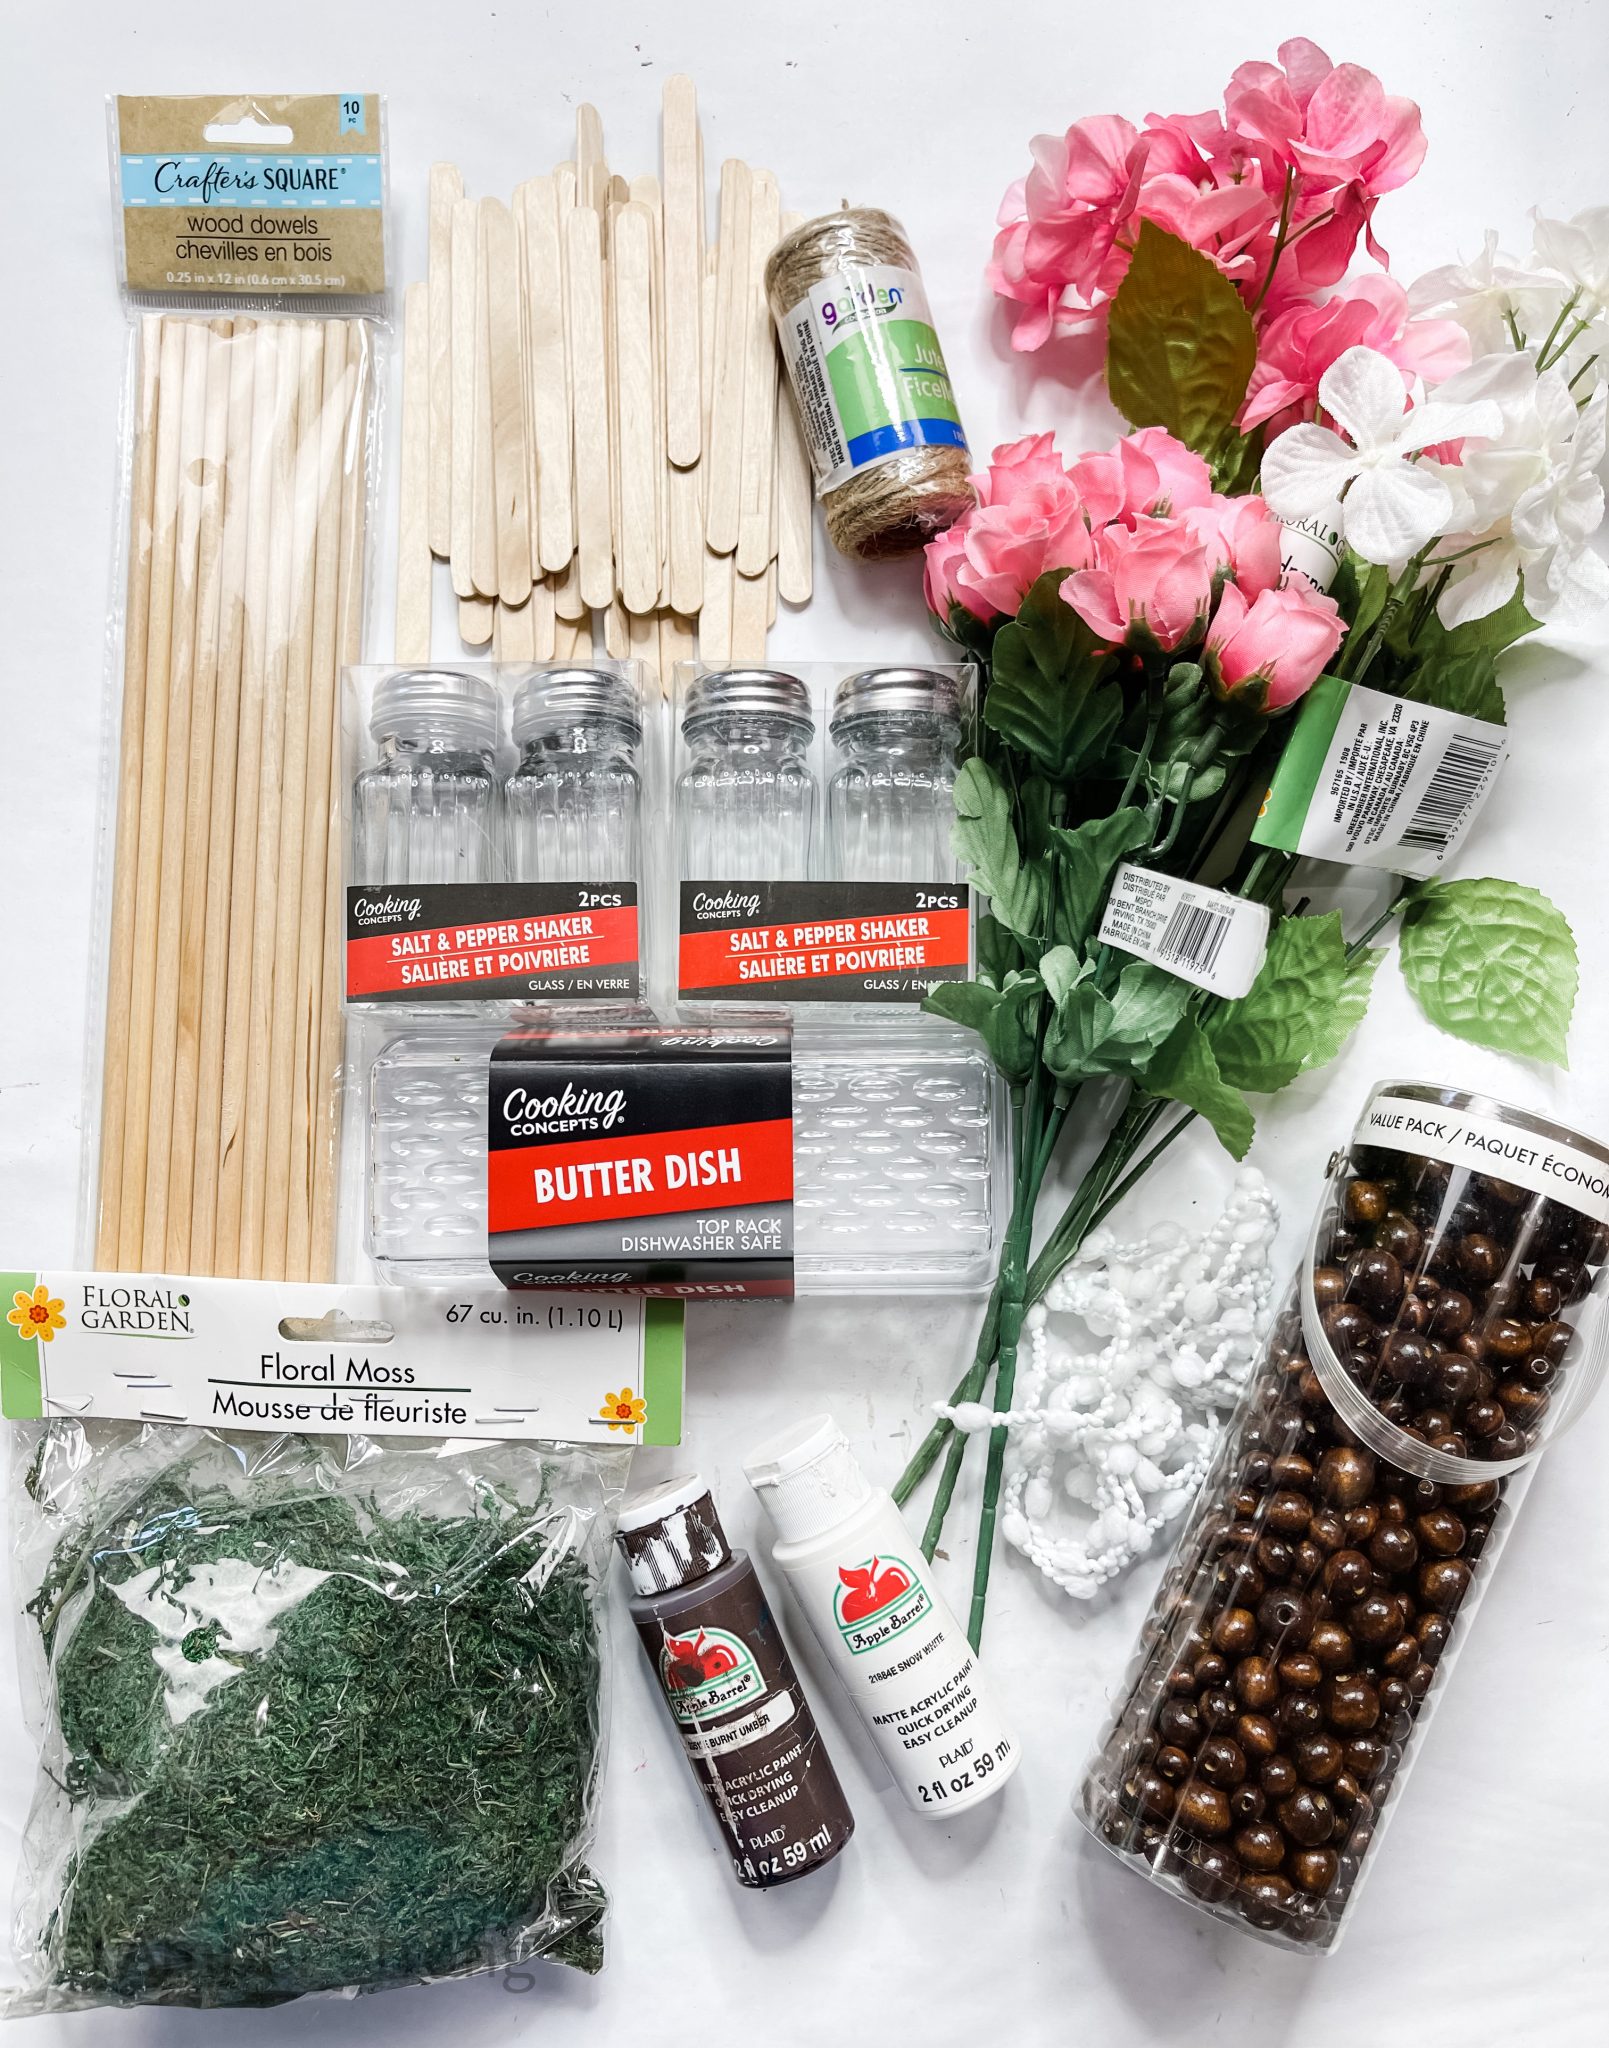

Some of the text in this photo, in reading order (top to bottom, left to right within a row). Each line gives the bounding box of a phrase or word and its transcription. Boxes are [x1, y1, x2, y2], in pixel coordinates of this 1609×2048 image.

[343, 101, 360, 115] 10
[154, 162, 340, 204] Crafter's SQUARE
[187, 214, 318, 235] wood dowels
[176, 240, 332, 262] chevilles en bois
[166, 271, 345, 287] 0.25 in 12 in (0.6 cm 30.5 cm)
[803, 319, 845, 465] MADE CHINA CHINE
[904, 376, 951, 401] Ficell
[1392, 703, 1403, 723] 23320
[1388, 726, 1397, 735] VA
[1410, 720, 1419, 733] 4P3
[1417, 720, 1430, 742] CHINE
[1405, 734, 1416, 748] V5G
[1413, 743, 1422, 754] EN
[1402, 748, 1411, 759] BC
[1331, 747, 1350, 796] 967165 1908
[1334, 723, 1367, 823] IMPORTED BY IMPORTÉ PAR
[1346, 793, 1366, 835] GREENBRIER
[1378, 720, 1388, 734] INC.
[1367, 741, 1403, 824] IN CANADA AU CANADA
[1347, 802, 1355, 811] IN
[1357, 760, 1367, 776] AUX
[1387, 792, 1402, 813] CHINA
[1383, 814, 1391, 822] IN
[1351, 820, 1365, 841] VOLVO
[1364, 827, 1377, 844] DTSC
[1373, 822, 1387, 842] MADE
[1123, 872, 1171, 893] DISTRIBUTED BY
[354, 894, 421, 921] Cooking
[578, 891, 622, 908] 2PCS
[693, 890, 761, 917] Cooking
[915, 892, 958, 909] 2PCS
[1155, 892, 1166, 902] PAR
[358, 915, 402, 926] CONCEPTS
[696, 910, 741, 920] CONCEPTS
[1117, 900, 1157, 919] BENT BRANCH
[391, 916, 593, 957] SALT & PEPPER SHAKER
[730, 917, 929, 952] SALT & PEPPER SHAKER
[1111, 919, 1132, 933] MADE
[401, 942, 590, 984] SALIÈRE ET POIVRIÈRE
[738, 942, 925, 980] SALIÈRE ET POIVRIÈRE
[528, 978, 630, 991] GLASS EN VERRE
[863, 979, 900, 990] GLASS
[911, 980, 927, 990] EN
[503, 1082, 627, 1129] Cooking
[510, 1118, 599, 1137] CONCEPTS
[1370, 1113, 1404, 1130] VALUE
[1405, 1118, 1447, 1139] PACK
[1447, 1128, 1463, 1144] /
[1465, 1132, 1539, 1168] PAQUET
[534, 1147, 741, 1203] BUTTER DISH
[697, 1218, 781, 1234] TOP RACK
[622, 1235, 781, 1252] DISHWASHER SAFE
[513, 1270, 627, 1284] Cooking
[83, 1285, 178, 1309] FLORAL
[675, 1285, 745, 1294] DISH
[81, 1310, 190, 1332] GARDEN
[446, 1304, 623, 1333] 67 cu. in. (1.10 L)
[261, 1352, 415, 1383] Floral Moss
[213, 1390, 467, 1424] Mousse de fleuriste
[852, 1600, 924, 1651] Apple Barrel
[897, 1650, 923, 1672] SNOW
[921, 1632, 945, 1656] WHITE
[708, 1680, 748, 1705] Barrel
[873, 1658, 973, 1726] MATTE ACRYLIC PAINT
[897, 1685, 972, 1736] QUICK DRYING
[709, 1730, 739, 1749] BURNT
[738, 1713, 771, 1737] UMBER
[903, 1698, 978, 1749] EASY CLEANUP
[939, 1740, 974, 1769] PLAID
[725, 1743, 802, 1791] ACRYLIC PAINT
[918, 1785, 933, 1803] 2
[932, 1780, 948, 1800] fl
[950, 1772, 975, 1793] oz
[973, 1752, 995, 1778] 59
[747, 1770, 794, 1801] DRYING
[746, 1784, 799, 1817] CLEANUP
[749, 1828, 785, 1850] PLAID
[758, 1856, 782, 1876] oz
[782, 1841, 807, 1867] 59
[809, 1823, 832, 1854] ml
